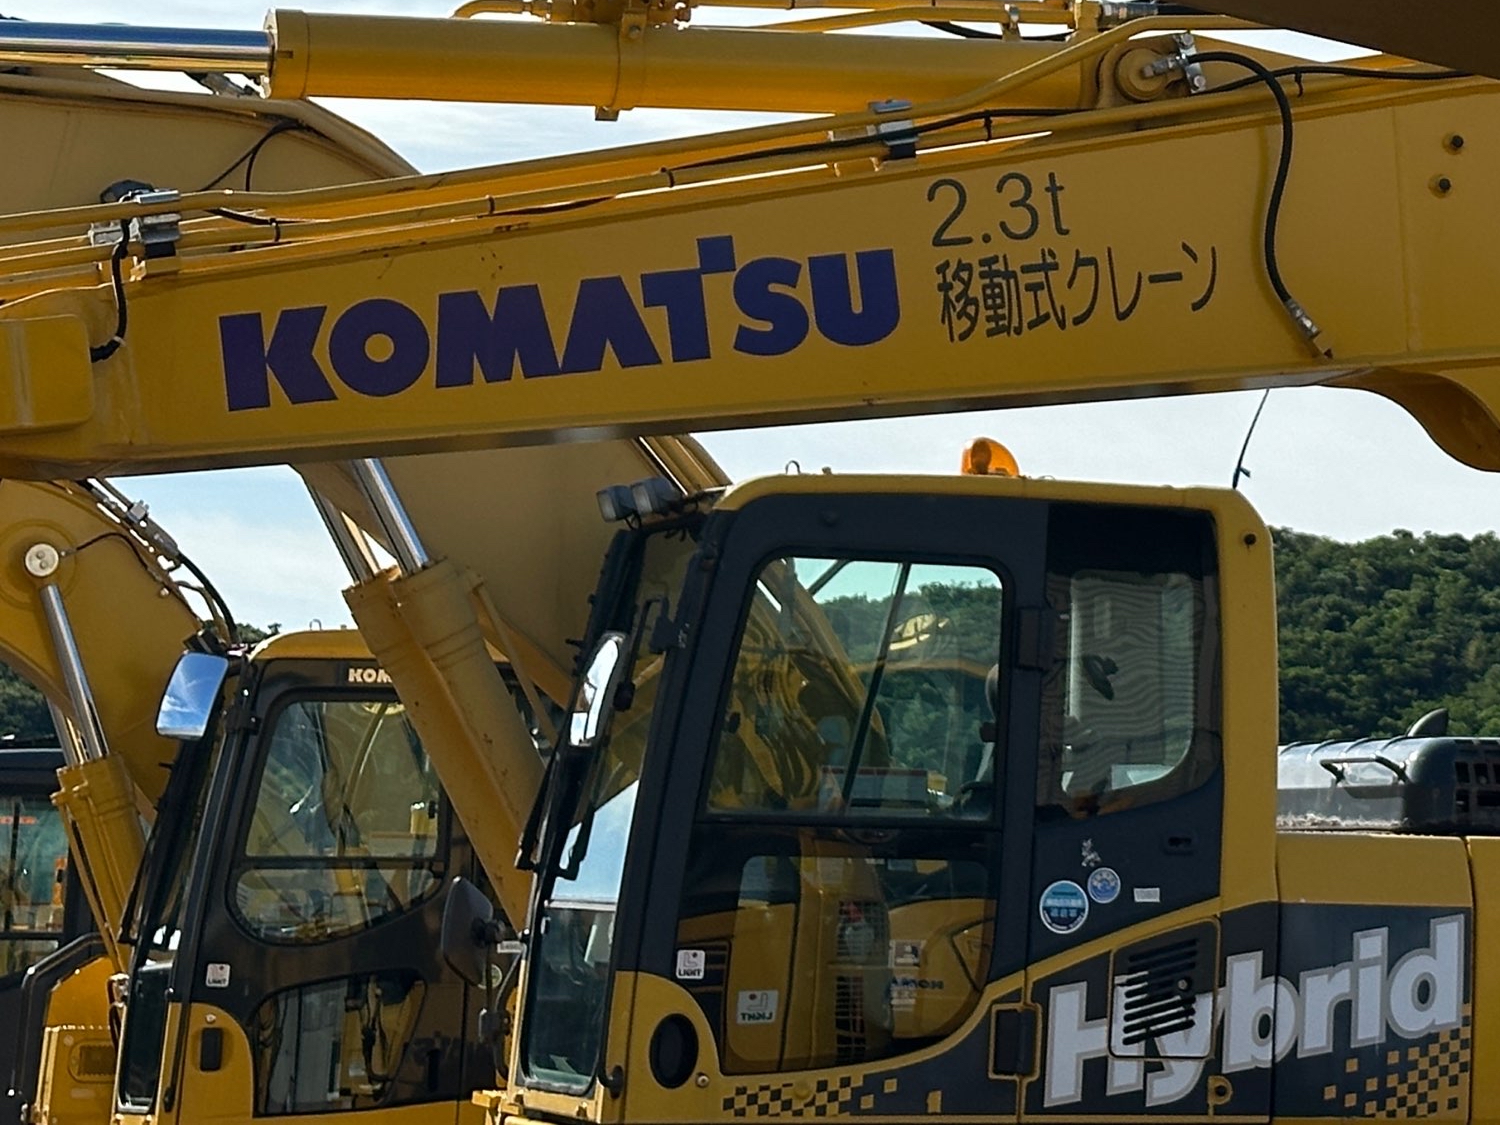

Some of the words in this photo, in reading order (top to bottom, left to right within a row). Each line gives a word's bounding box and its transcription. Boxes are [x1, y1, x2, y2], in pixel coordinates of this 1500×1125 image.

[926, 171, 1070, 247] 2.3t
[219, 235, 901, 411] KOMATSU
[936, 241, 1218, 343] 移動式クレーン
[1044, 914, 1464, 1107] Hybrid
